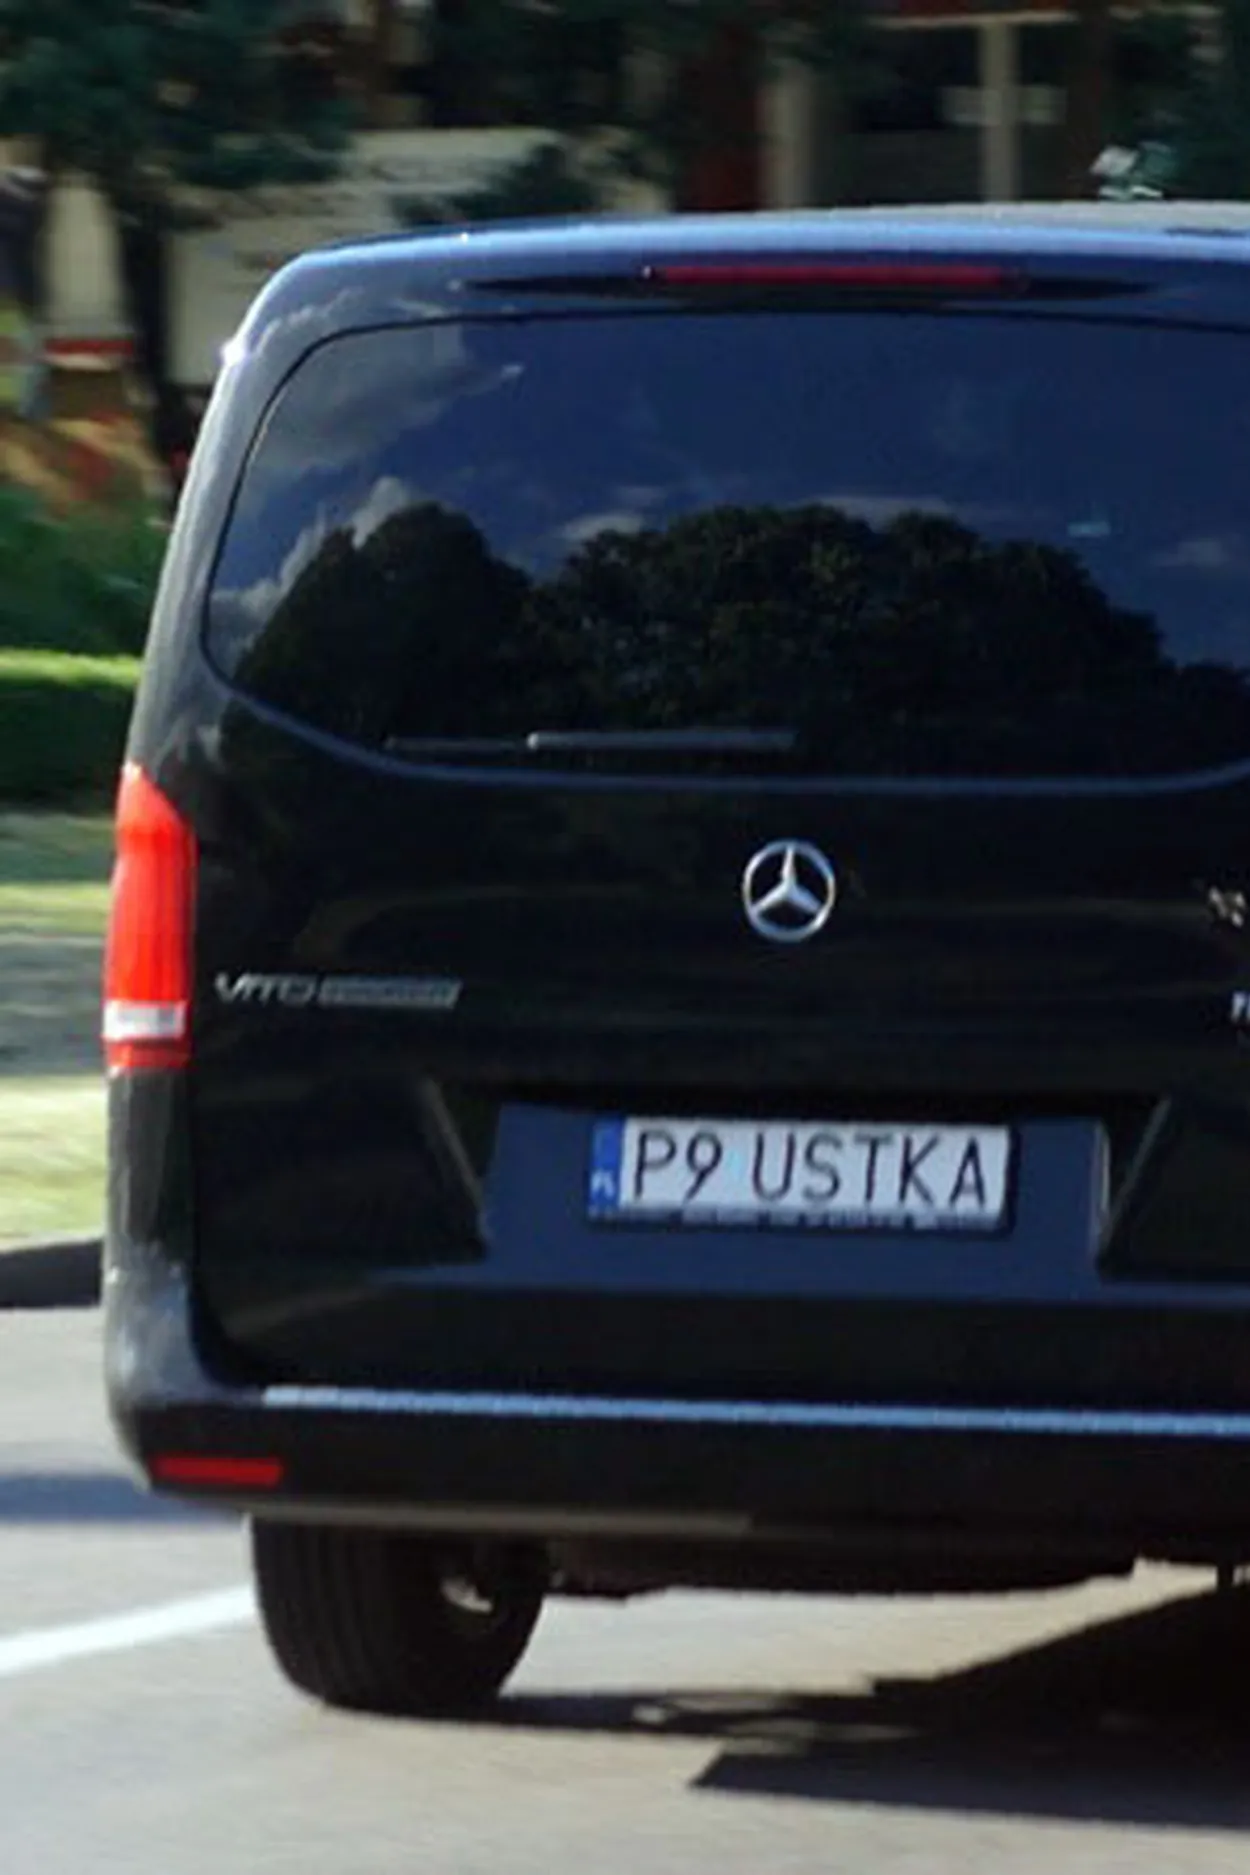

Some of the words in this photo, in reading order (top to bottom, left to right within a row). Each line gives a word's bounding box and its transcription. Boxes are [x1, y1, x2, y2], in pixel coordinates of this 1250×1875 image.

[214, 973, 318, 1003] VITO
[633, 1128, 724, 1204] P9
[751, 1131, 987, 1208] USTKA
